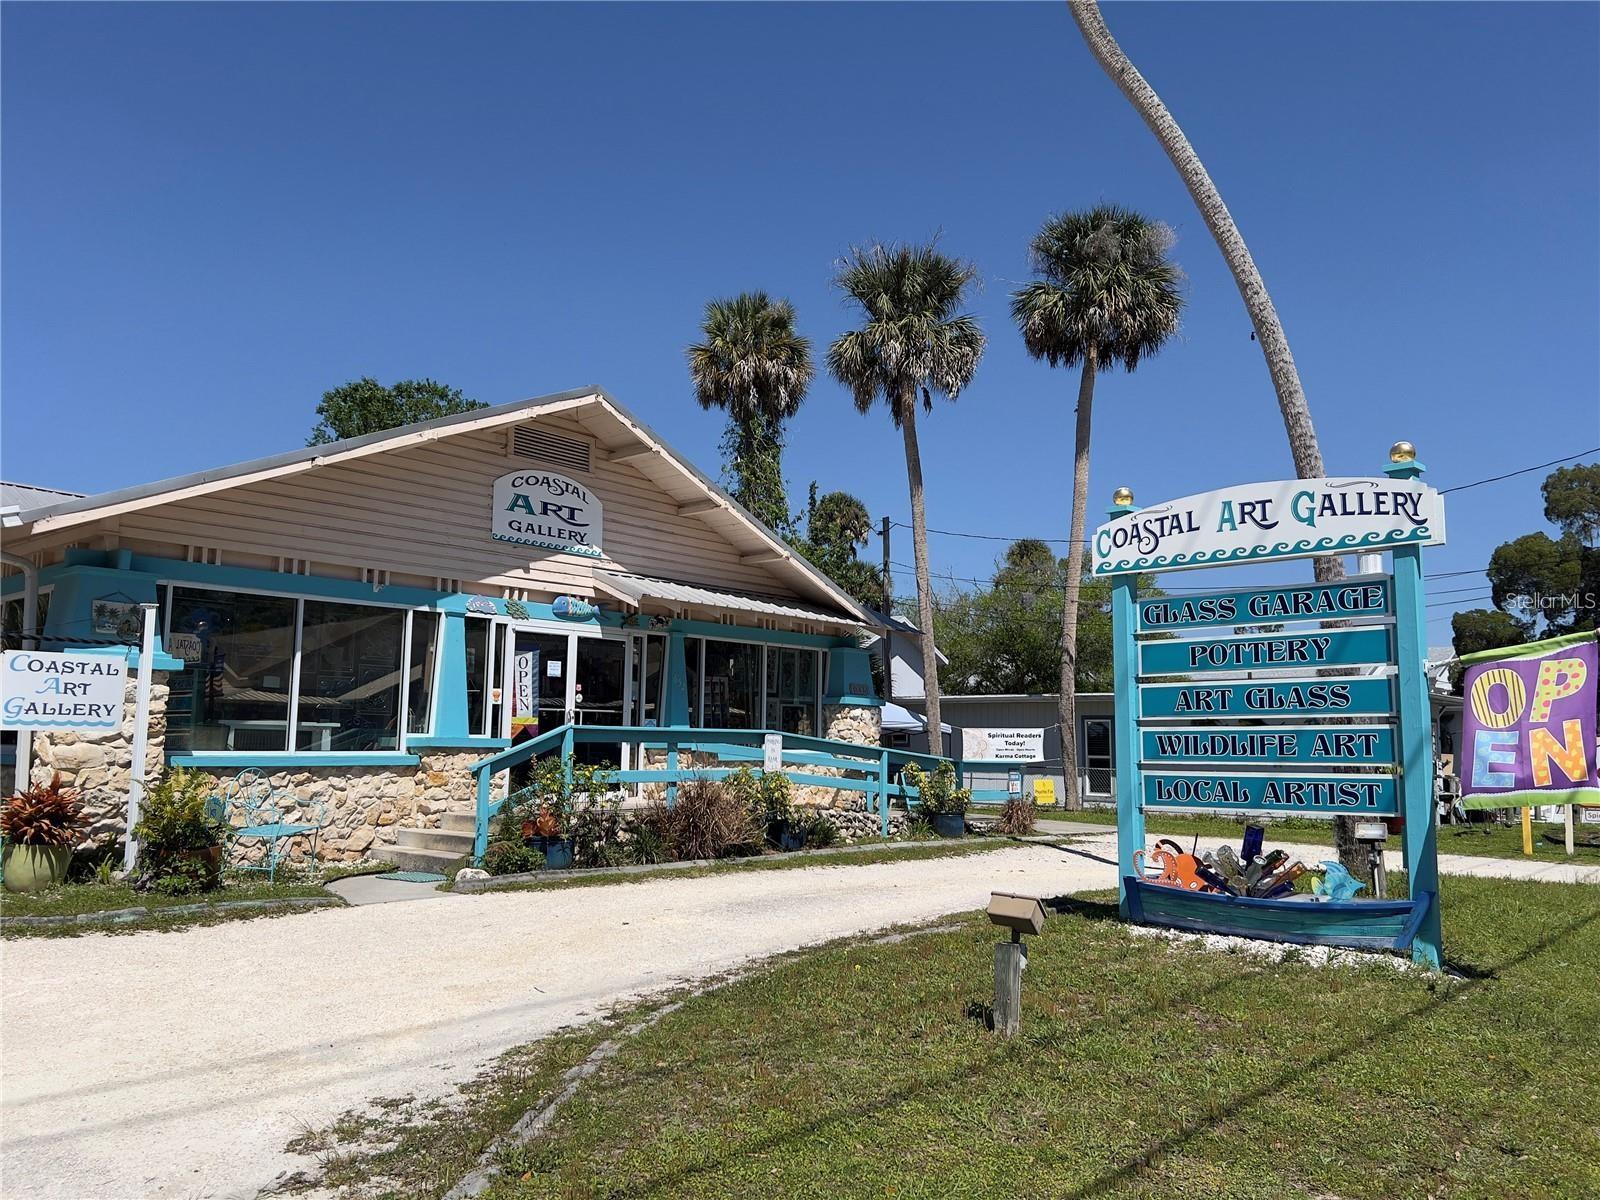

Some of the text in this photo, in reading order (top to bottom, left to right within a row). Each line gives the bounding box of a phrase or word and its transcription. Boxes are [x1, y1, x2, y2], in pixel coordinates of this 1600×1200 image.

[511, 475, 589, 505] COASTAL
[504, 492, 590, 527] ART
[508, 520, 590, 546] GALLERY
[1096, 490, 1428, 558] COASTAL ART GALLERY
[1143, 585, 1383, 625] GLASS GARAGE
[9, 654, 120, 676] COASTAL
[1189, 636, 1331, 667] POTTERY
[35, 677, 92, 697] ART
[518, 656, 530, 712] OPEN
[1174, 684, 1352, 712] ART GLASS
[3, 696, 116, 719] GALLERY
[1155, 733, 1379, 758] WILDLIFE ART
[1155, 779, 1382, 807] LOCAL ARTIST
